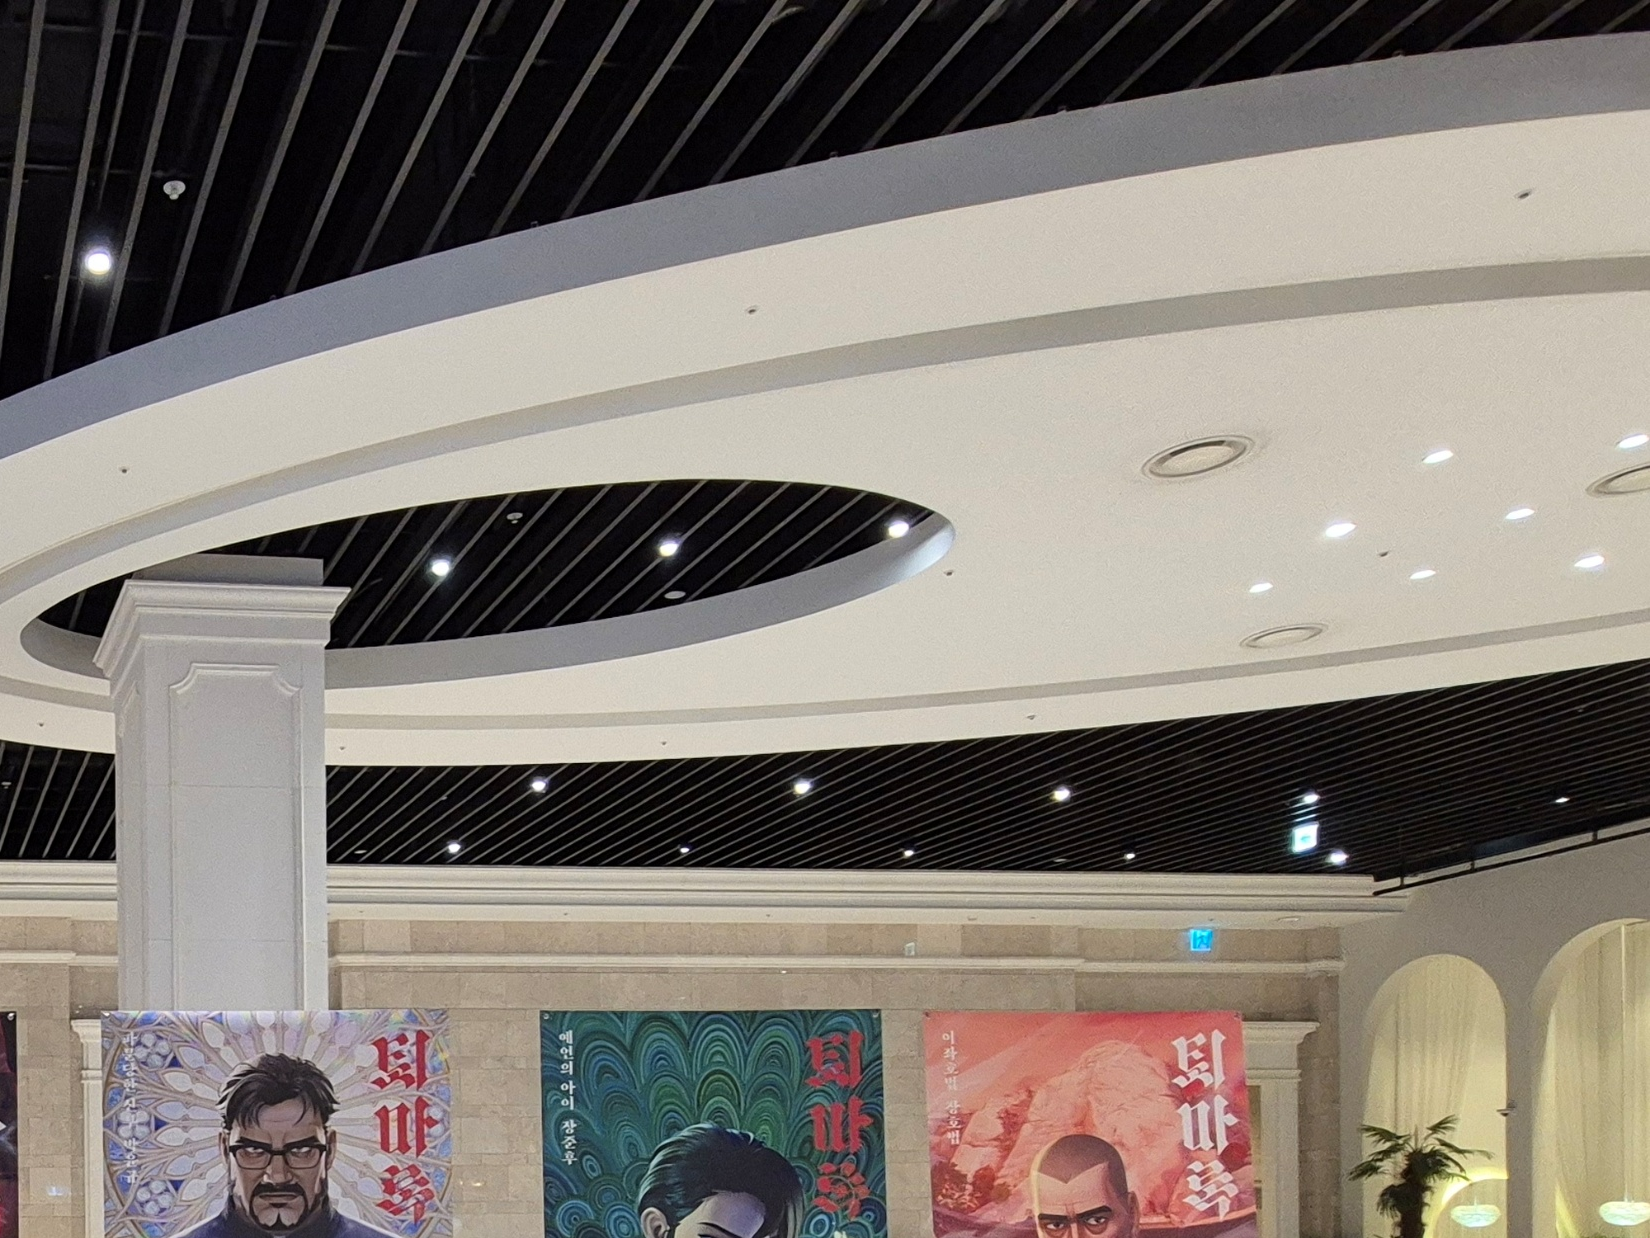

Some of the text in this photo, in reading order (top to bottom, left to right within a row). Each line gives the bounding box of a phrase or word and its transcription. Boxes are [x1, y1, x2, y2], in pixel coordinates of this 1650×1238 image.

[370, 1029, 440, 1226] 퇴마록
[559, 1029, 578, 1165] 예언의 아이 장준후
[805, 1030, 875, 1221] 퇴마록
[1171, 1029, 1240, 1223] 퇴마록
